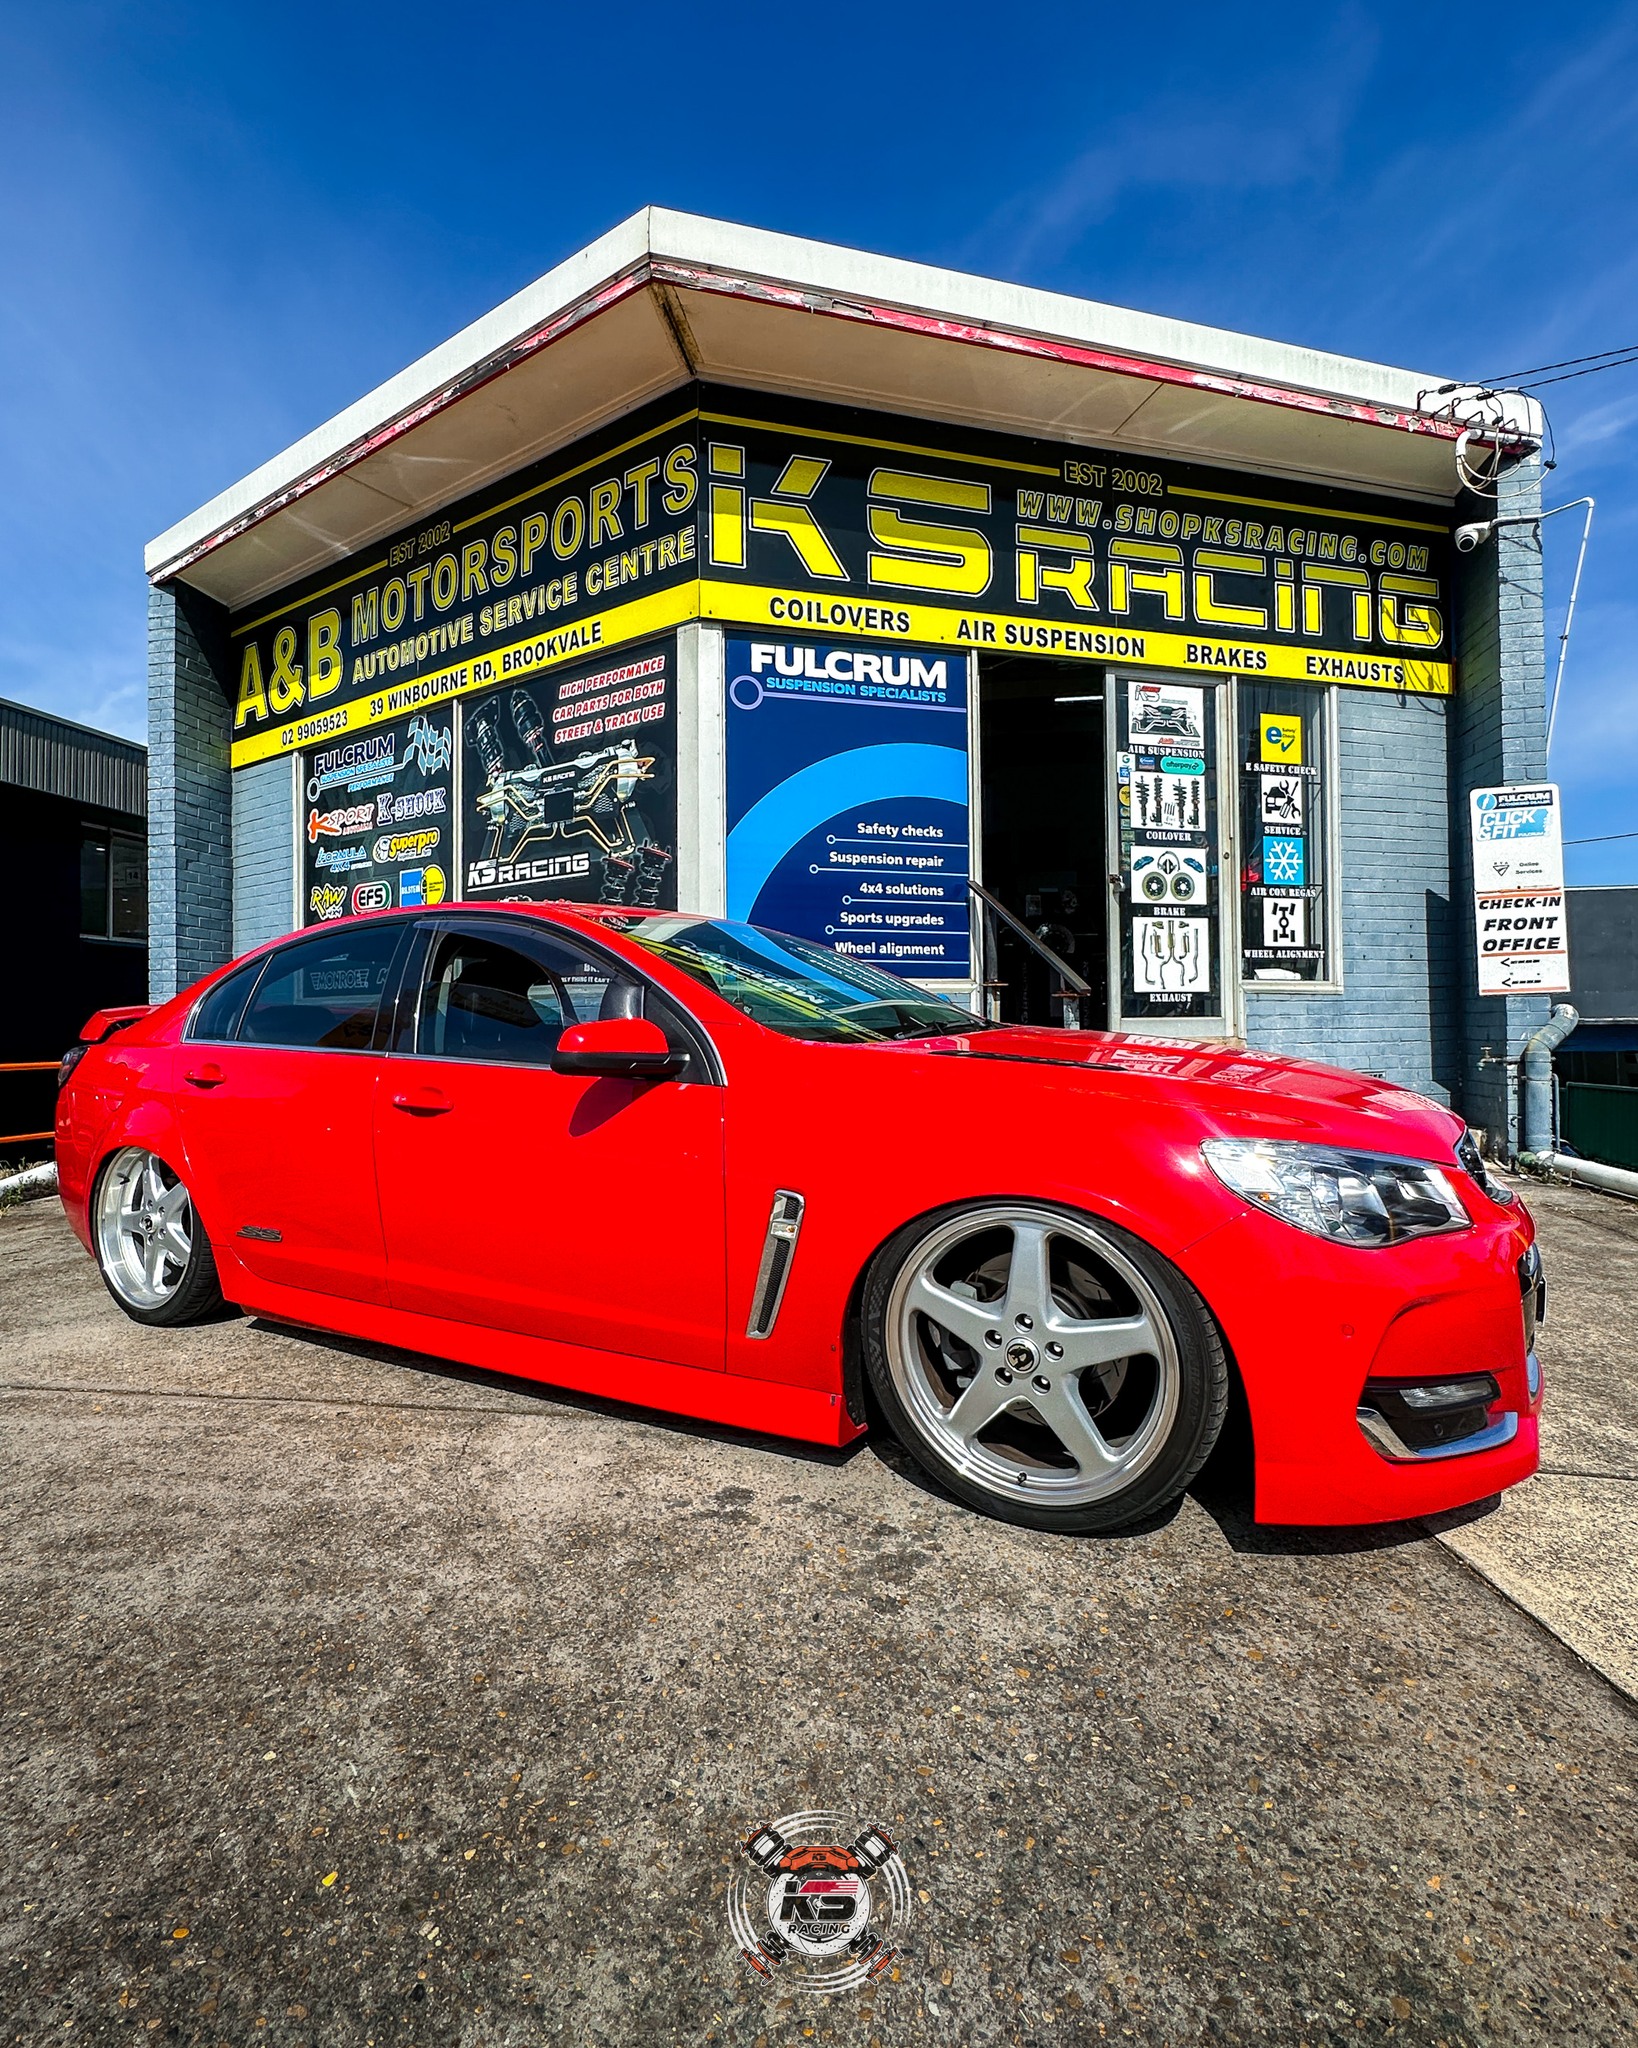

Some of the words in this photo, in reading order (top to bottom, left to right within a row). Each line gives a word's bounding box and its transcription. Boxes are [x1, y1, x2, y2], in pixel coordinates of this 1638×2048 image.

[1064, 460, 1106, 488] EST
[1112, 468, 1163, 496] 2002
[1017, 489, 1429, 571] WWW.SHOPKSRACING.COM
[350, 443, 698, 646] MOTORSPORTS
[389, 537, 416, 567] EST
[418, 520, 451, 554] 2002
[351, 613, 474, 685] AUTOMOTIVE
[479, 572, 578, 637] SERVICE
[585, 525, 695, 597] CENTRE
[770, 597, 910, 633] COILOVERS
[957, 619, 996, 642] AIR
[1004, 623, 1145, 658] SUSPENSION
[1186, 643, 1267, 670] BRAKES
[1306, 656, 1404, 684] EXHAUSTS
[234, 607, 343, 730] A&B
[750, 643, 947, 689] FULCRUM
[281, 729, 295, 747] 02
[296, 710, 349, 742] 99059523
[370, 697, 385, 717] 39
[388, 670, 469, 713] WINBOURNE
[473, 660, 497, 685] RD,
[503, 620, 602, 674] BROOKVALE
[559, 678, 584, 699] HIGH
[585, 655, 665, 690] PERFORMANCE
[766, 677, 857, 697] SUSPENSION
[860, 684, 946, 703] SPECIALISTS
[552, 705, 574, 723] CAR
[575, 697, 609, 717] PARTS
[610, 689, 632, 707] FOR
[634, 679, 665, 700] BOTH
[554, 724, 592, 744] STREET
[593, 720, 604, 733] &
[605, 711, 639, 731] TRACK
[642, 703, 665, 720] USE
[314, 733, 395, 776] FULCRUM
[1128, 744, 1146, 755] AIR
[1148, 747, 1205, 759] SUSPENSION
[320, 768, 355, 784] SUSPENSION
[1245, 763, 1251, 771] E
[1253, 763, 1286, 773] SAFETY
[1288, 765, 1317, 775] CHECK
[1498, 792, 1550, 802] FULCRUM
[1482, 810, 1536, 826] CLICK
[857, 823, 899, 837] Safety
[902, 825, 944, 838] checks
[1146, 830, 1192, 841] COILOVER
[1264, 826, 1301, 835] SERVICE
[829, 851, 903, 868] Suspension
[905, 855, 944, 870] repair
[359, 887, 383, 906] EFS
[859, 883, 883, 895] 4x4
[885, 883, 944, 896] solutions
[1251, 887, 1267, 896] AIR
[1268, 887, 1286, 896] CON
[1288, 888, 1316, 897] REGAS
[1153, 907, 1186, 916] BRAKE
[1479, 896, 1561, 910] CHECK-IN
[840, 912, 883, 927] Sports
[886, 914, 944, 929] upgrades
[1484, 917, 1558, 931] FRONT
[835, 941, 876, 955] Wheel
[879, 942, 945, 958] alignment
[1483, 937, 1560, 951] OFFICE
[1244, 949, 1274, 958] WHEEL
[1276, 950, 1325, 959] ALIGNMENT
[1150, 993, 1193, 1003] EXHAUST
